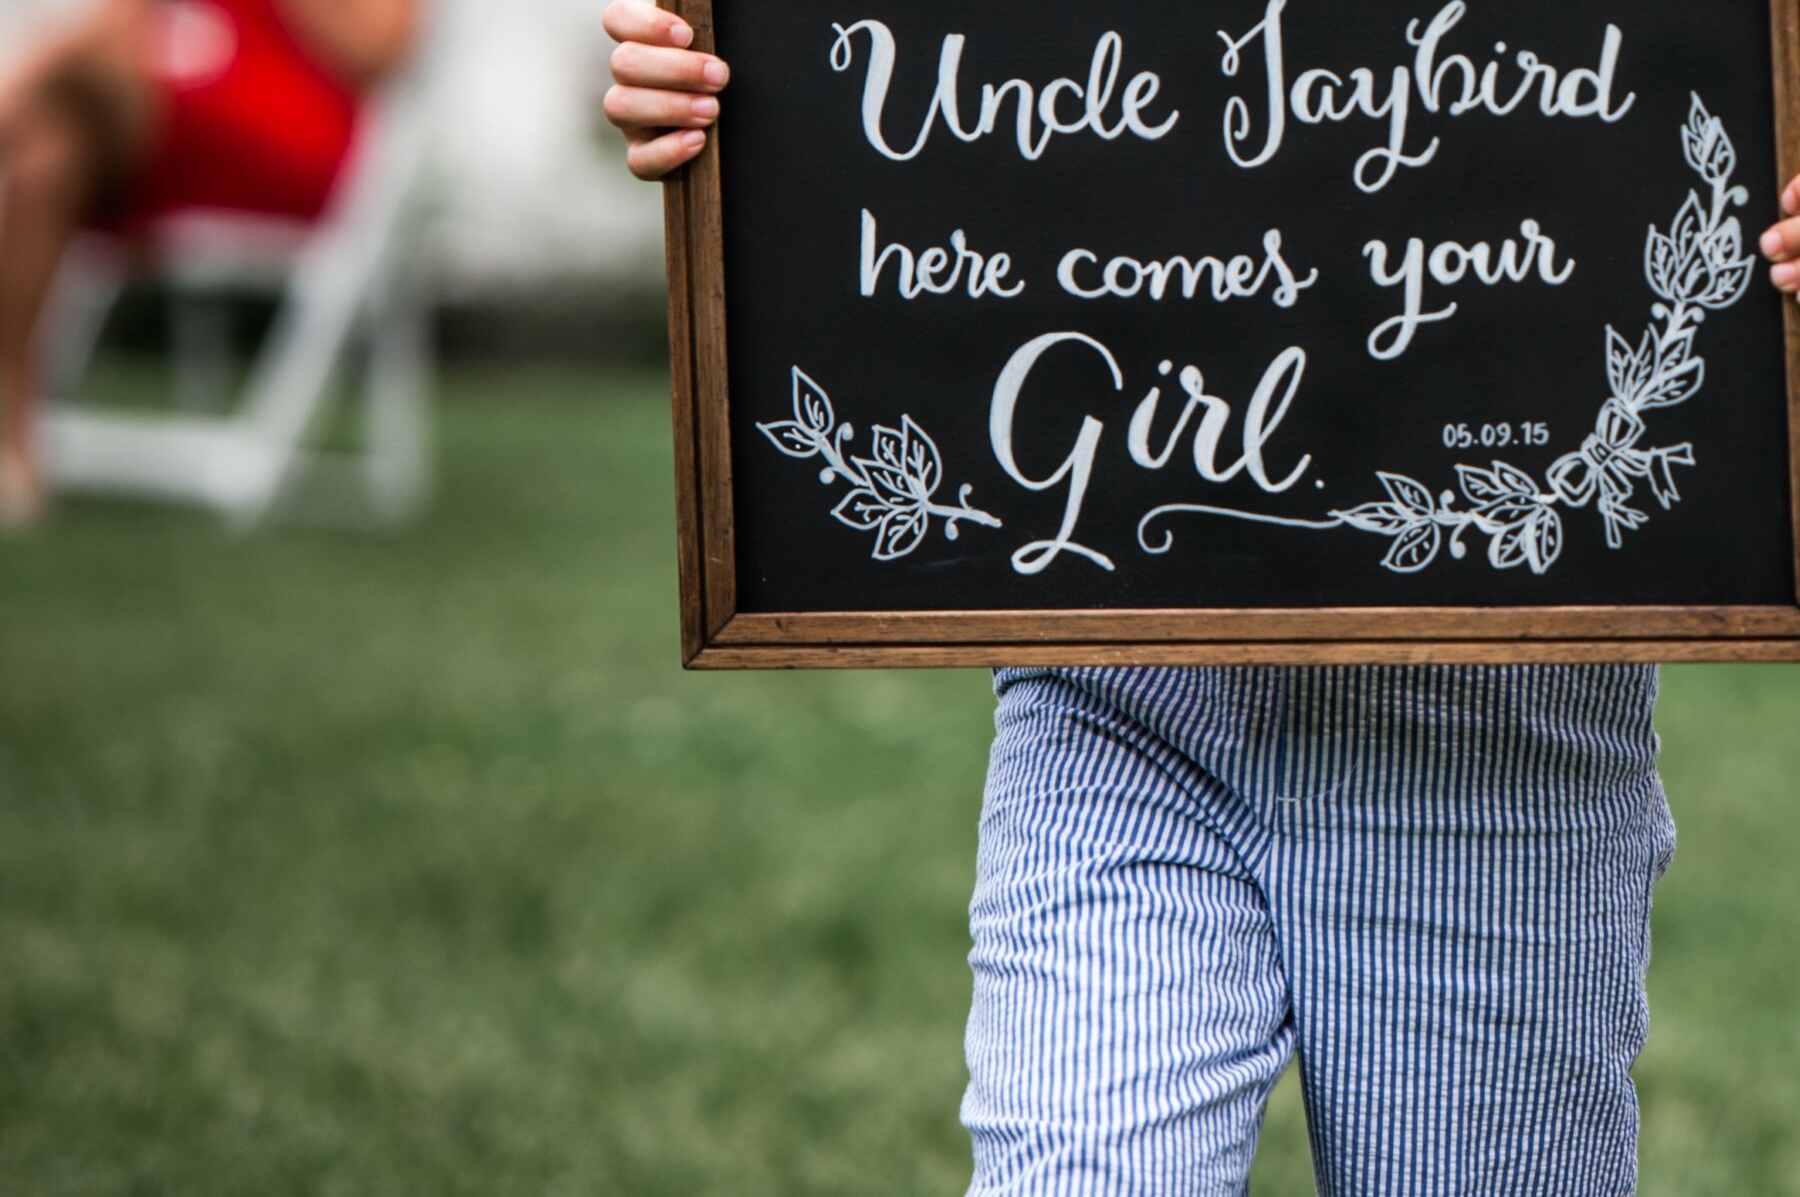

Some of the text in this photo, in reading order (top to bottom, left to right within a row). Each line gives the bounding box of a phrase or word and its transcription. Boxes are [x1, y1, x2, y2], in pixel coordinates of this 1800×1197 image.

[829, 19, 1180, 161] Uncle
[860, 208, 1576, 360] here comes your
[989, 331, 1325, 575] Girl.
[1442, 421, 1550, 449] 05.09.15
